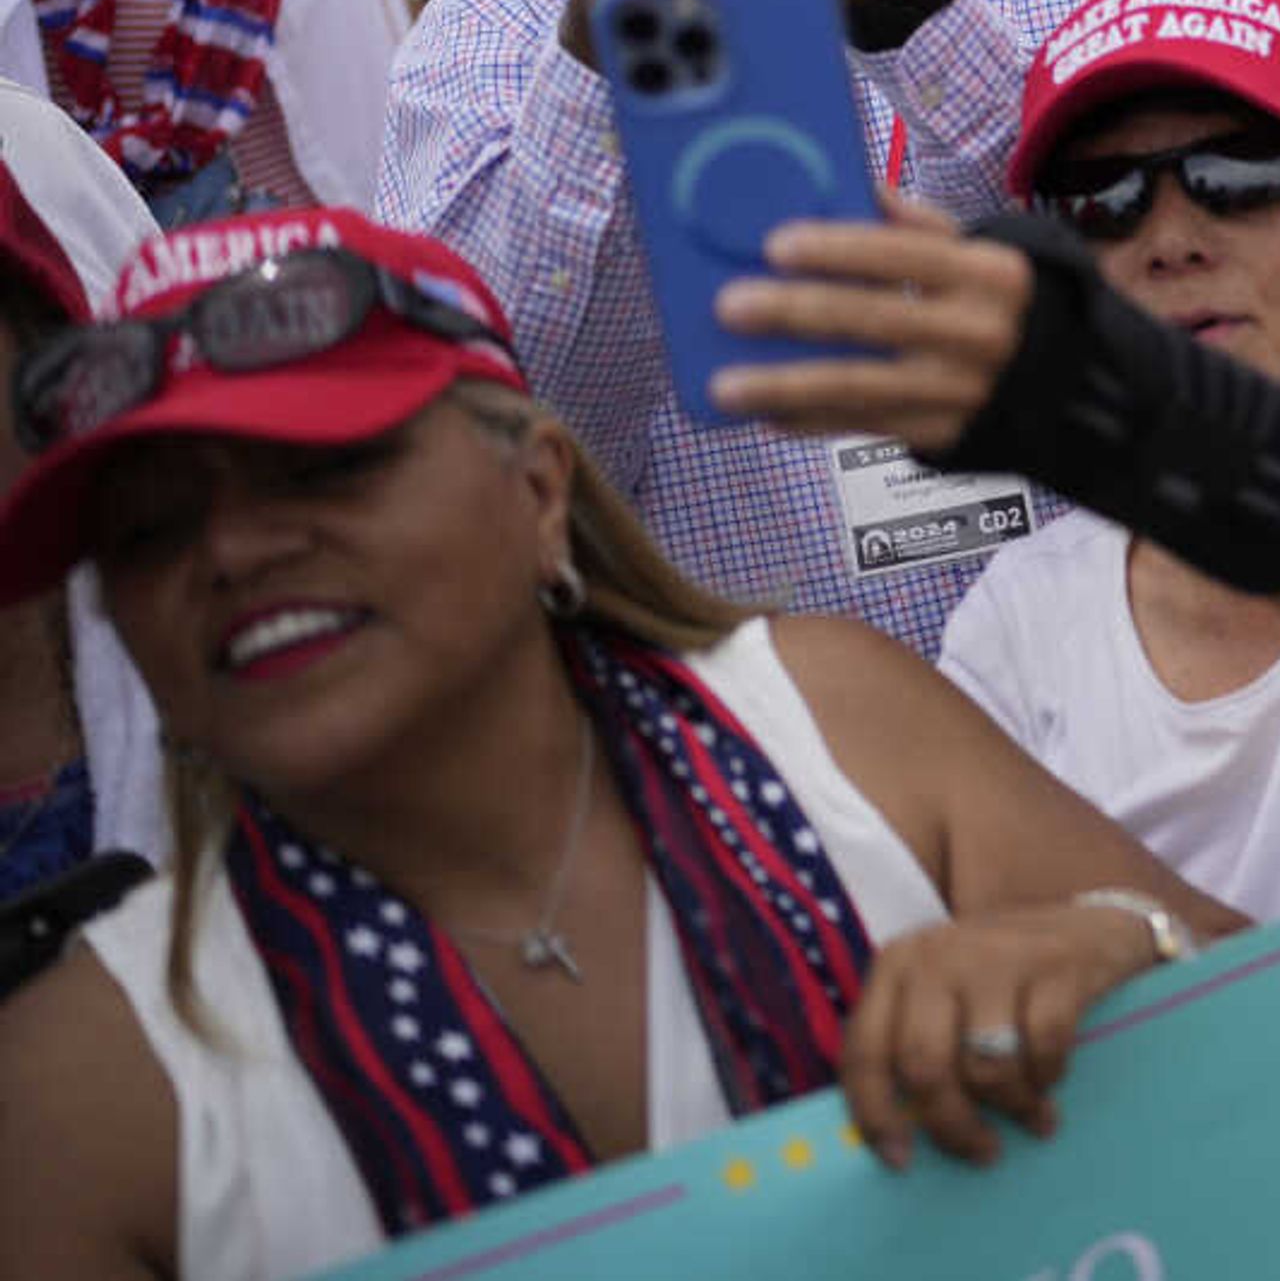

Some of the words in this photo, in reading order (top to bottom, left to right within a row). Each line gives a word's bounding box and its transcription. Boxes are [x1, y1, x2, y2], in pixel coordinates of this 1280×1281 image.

[1053, 12, 1150, 85] GREAT
[1156, 11, 1274, 58] AGAIN
[893, 519, 957, 545] 2024
[978, 506, 1023, 534] CD2
